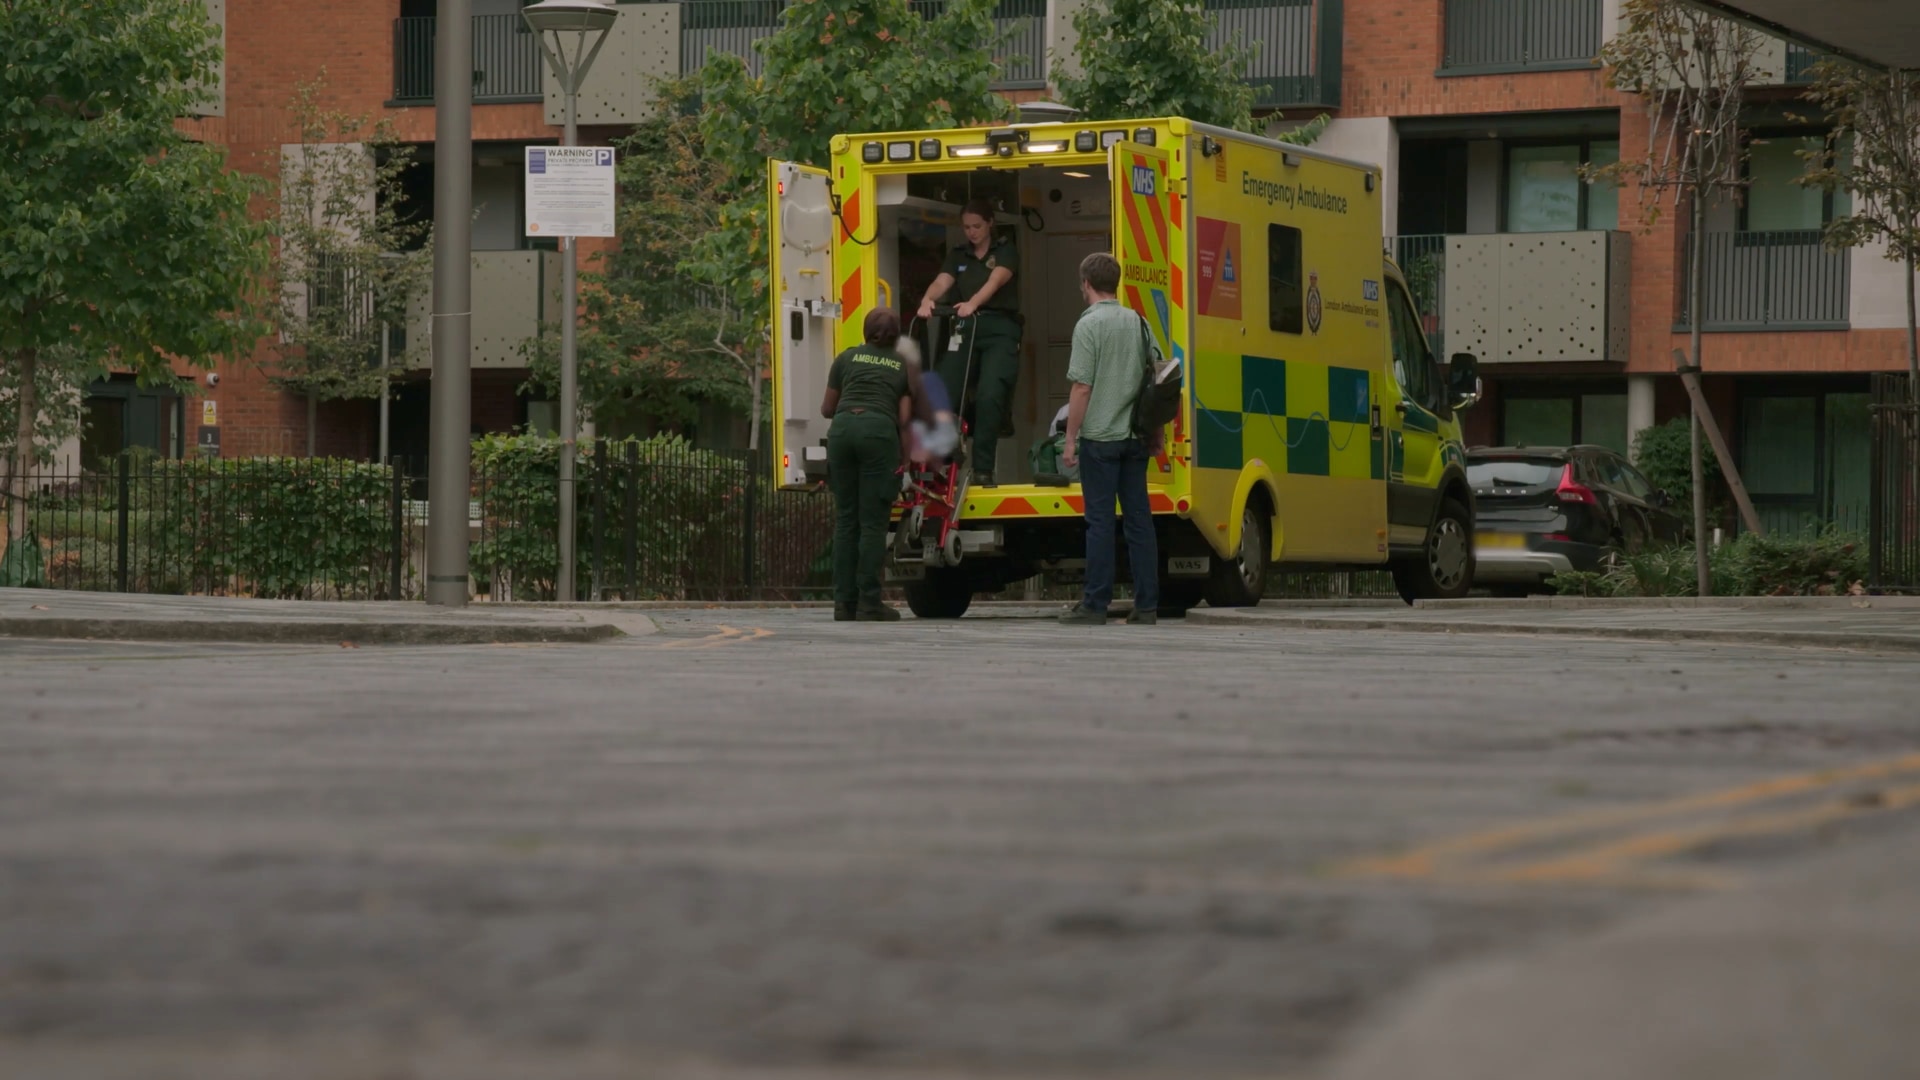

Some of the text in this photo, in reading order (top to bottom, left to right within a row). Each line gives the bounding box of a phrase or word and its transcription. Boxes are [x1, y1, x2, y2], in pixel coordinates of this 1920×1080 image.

[548, 149, 593, 157] WARNING
[597, 150, 610, 165] P
[1133, 167, 1155, 194] NHS
[1242, 170, 1295, 210] Emergency
[1297, 182, 1347, 214] Ambulance
[1125, 264, 1168, 286] AMBULANCE
[1202, 265, 1212, 278] 999
[1364, 280, 1378, 300] NHS
[852, 353, 902, 371] AMBULANCE
[1174, 560, 1202, 570] WAS
